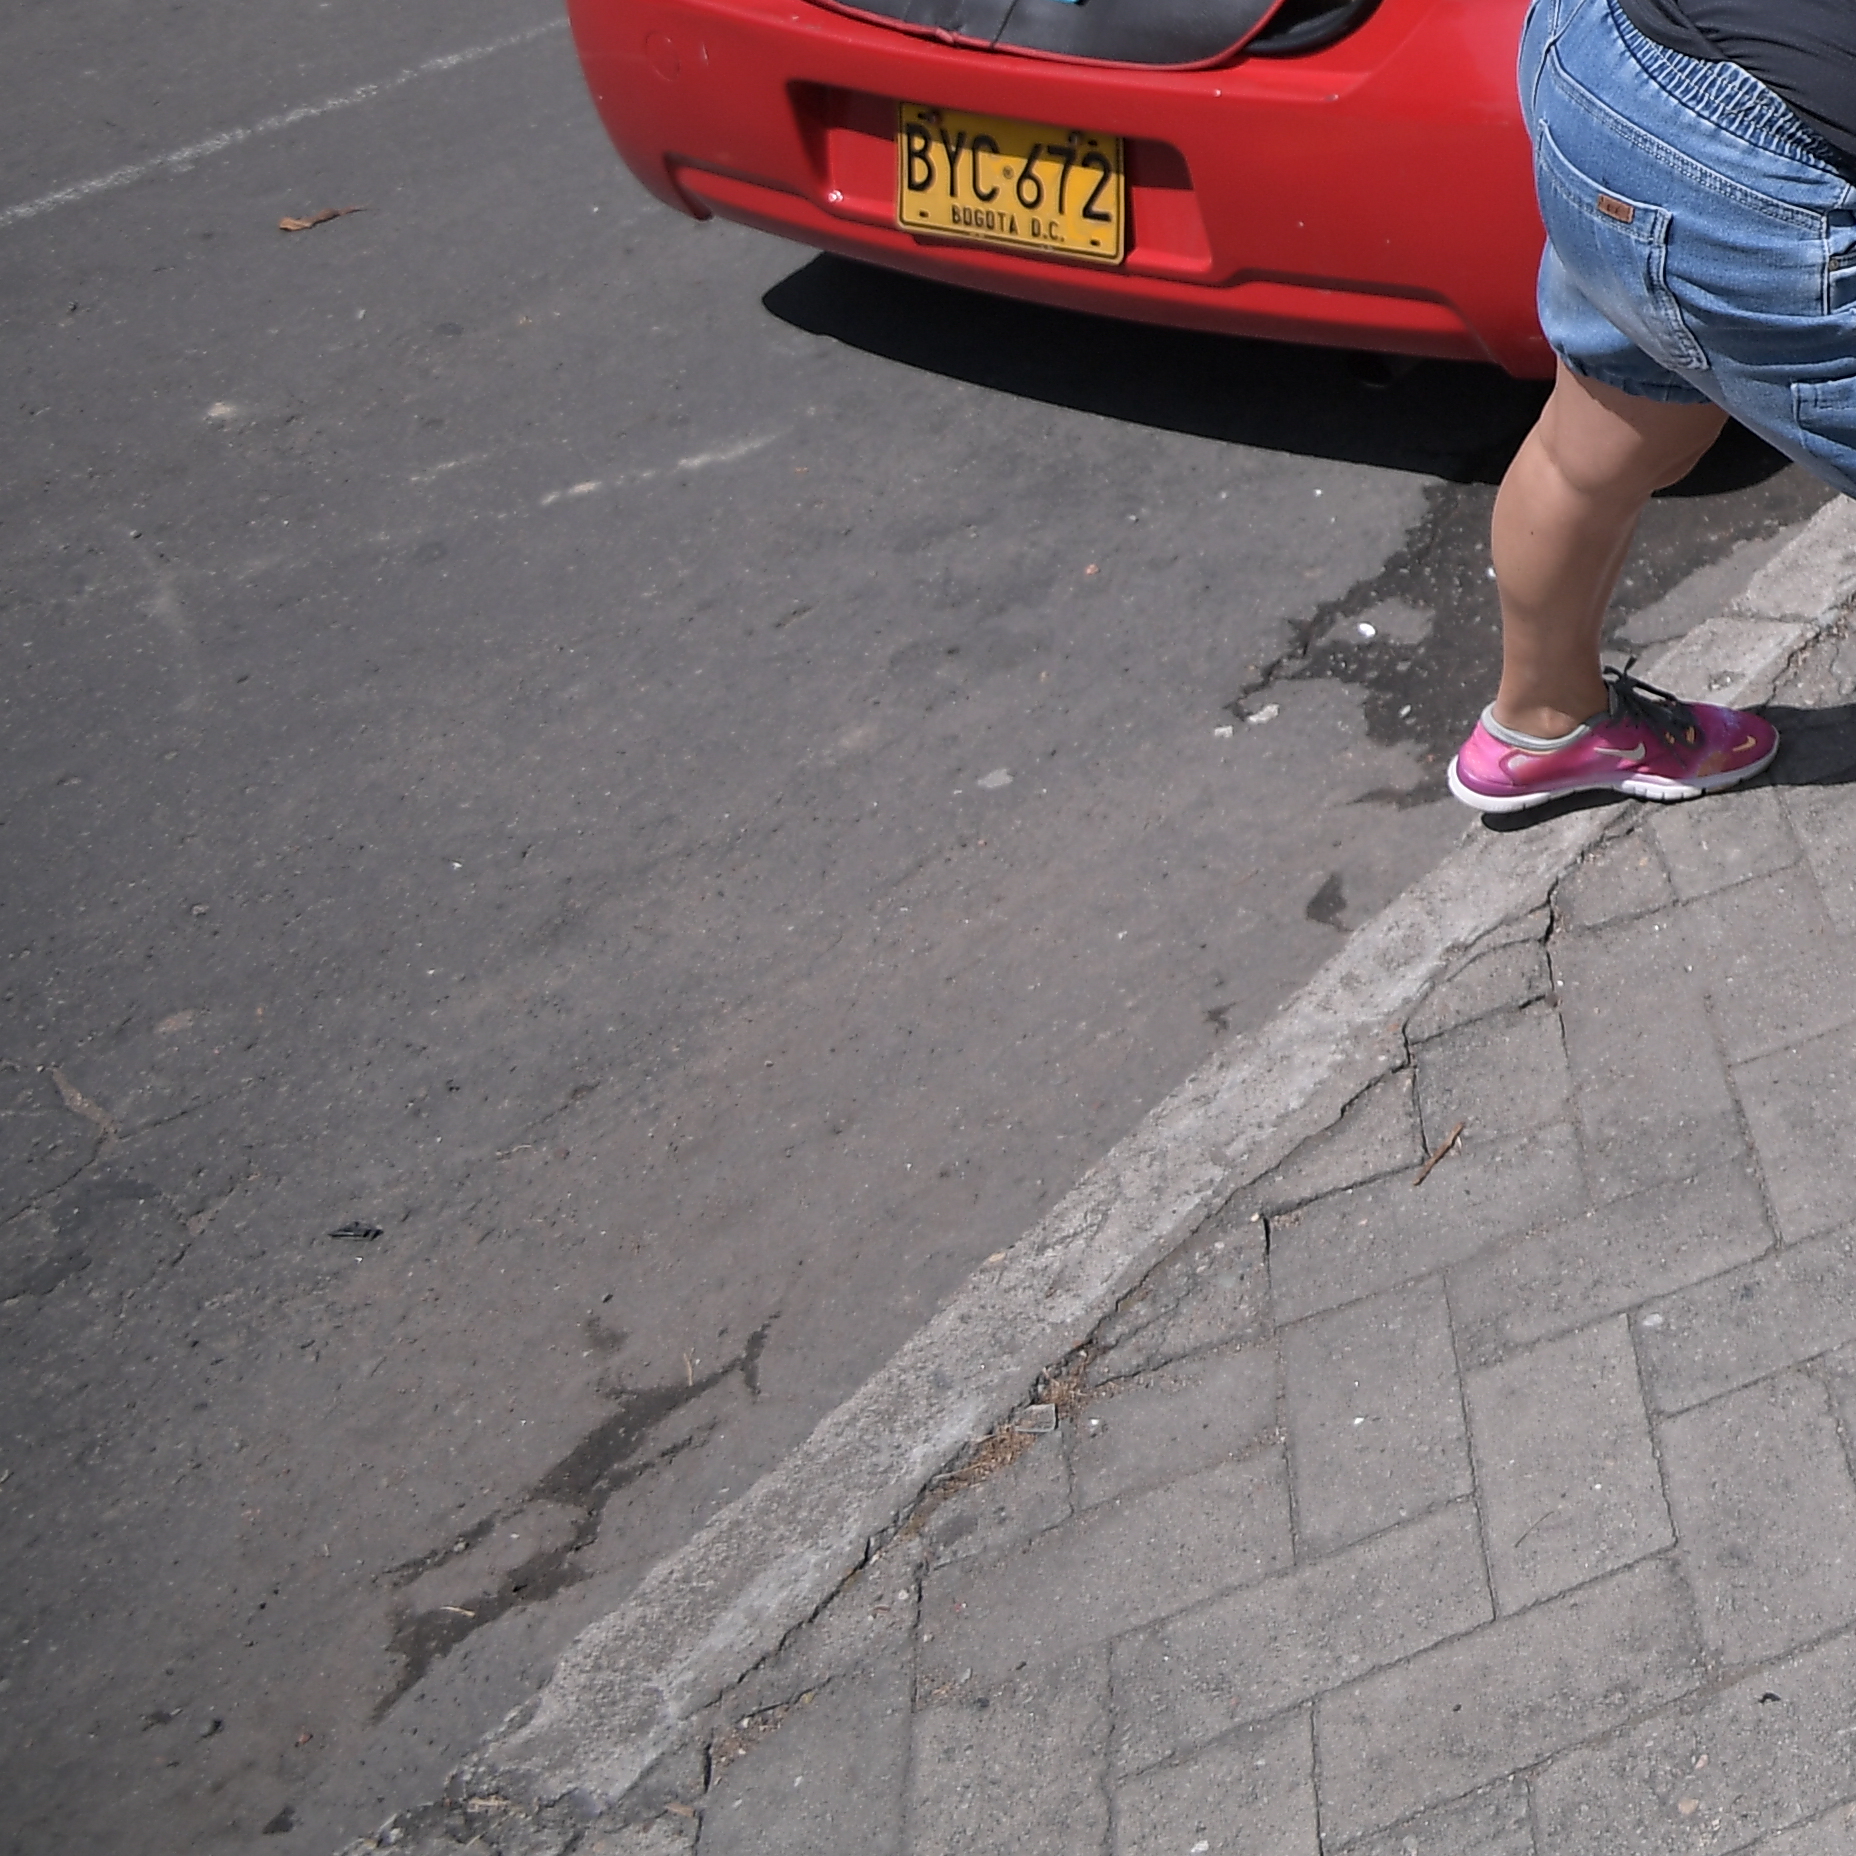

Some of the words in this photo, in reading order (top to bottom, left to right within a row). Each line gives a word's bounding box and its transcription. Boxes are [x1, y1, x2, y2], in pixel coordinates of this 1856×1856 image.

[907, 122, 1000, 202] BYC
[1016, 143, 1113, 223] 672
[951, 203, 1019, 236] BOGOTA
[1032, 216, 1066, 244] D.C.
